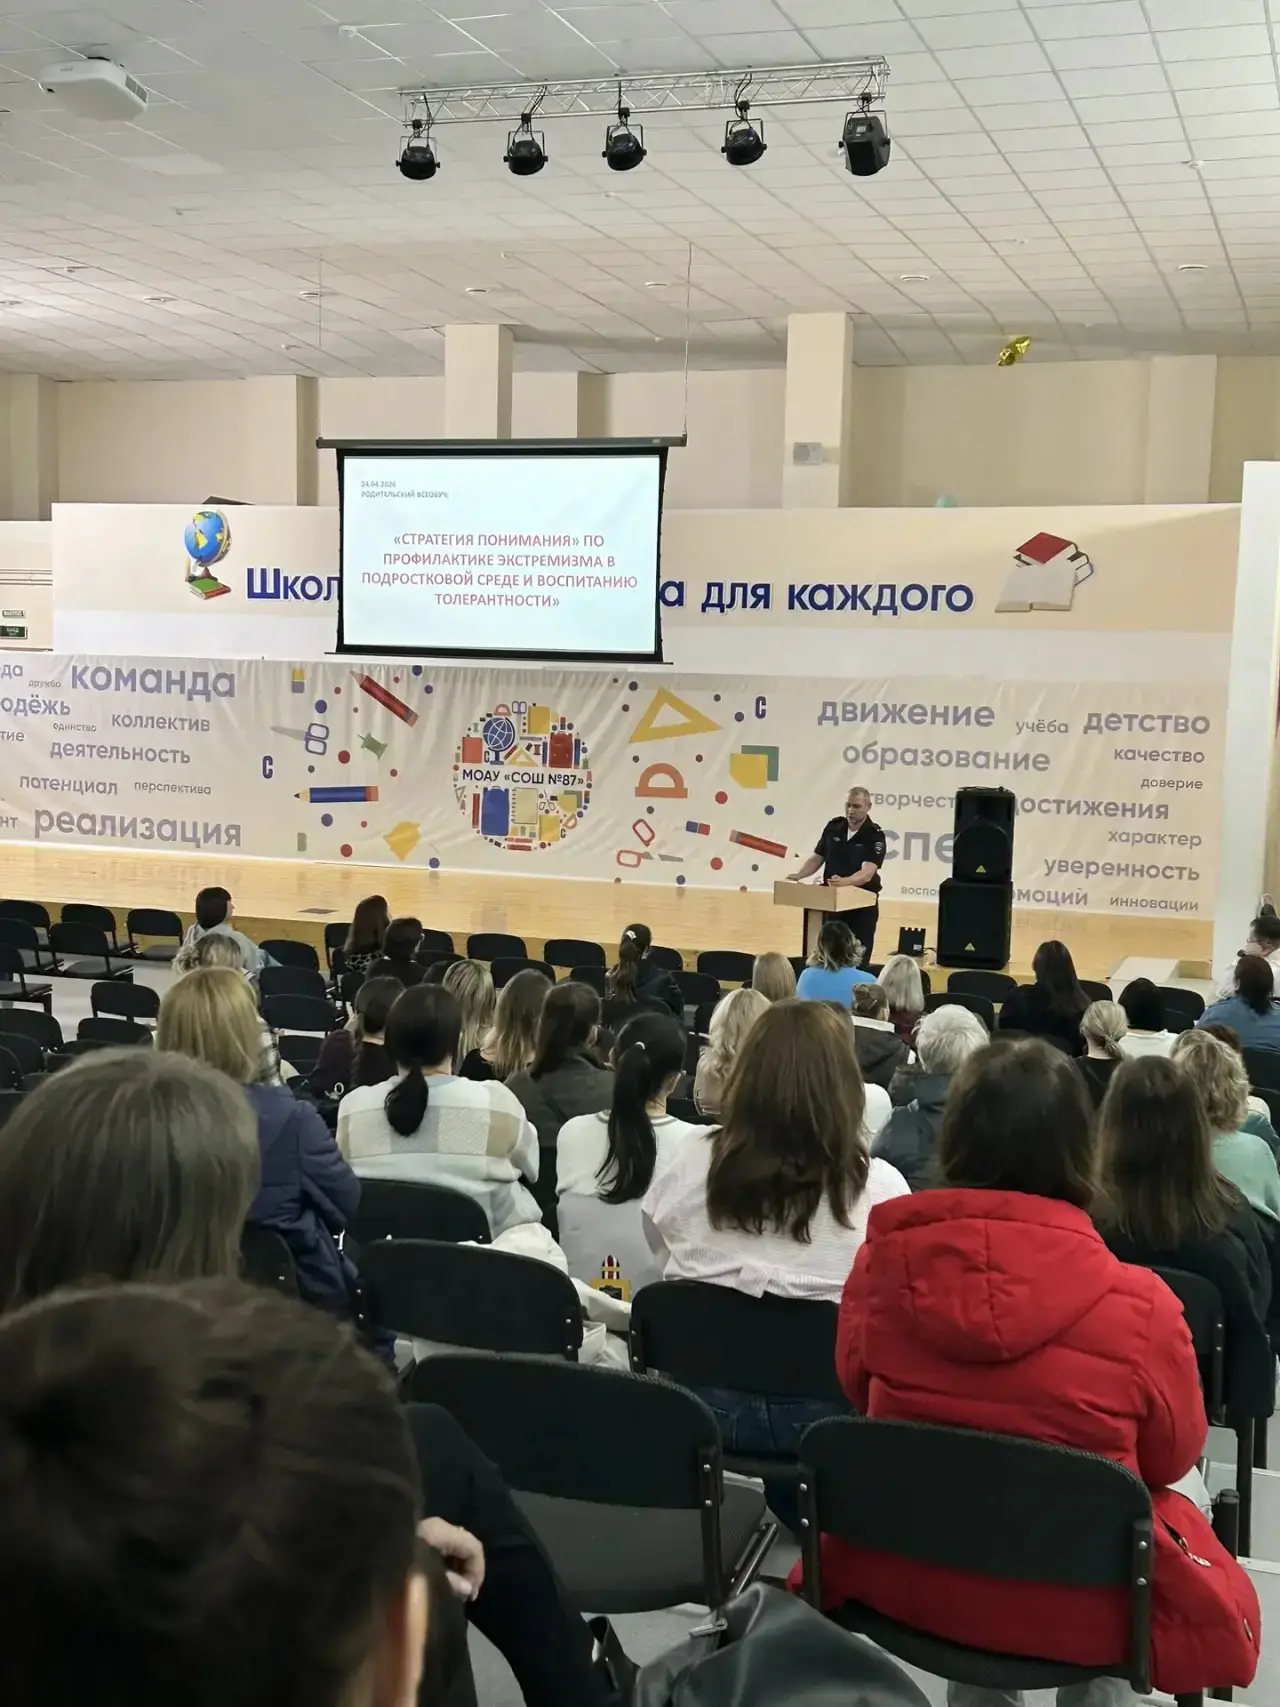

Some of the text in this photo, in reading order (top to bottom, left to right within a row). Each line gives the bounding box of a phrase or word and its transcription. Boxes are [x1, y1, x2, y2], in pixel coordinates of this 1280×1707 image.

[361, 489, 415, 499] РОДИТЕЛЬСКИЙ
[394, 532, 604, 549] «СТРАТЕГИЯ ПОНИМАНИЯ» ПО
[383, 552, 615, 569] ПРОФИЛАКТИКЕ ЭКСТРЕМИЗМА В
[362, 569, 638, 590] ПОДРОСТКОВОЙ СРЕДЕ И ВОСПИТАНИЮ
[435, 592, 560, 609] ТОЛЕРАНТНОСТИ»
[701, 581, 771, 614] для
[788, 582, 974, 616] каждого
[0, 664, 24, 679] да
[71, 665, 236, 703] команда
[111, 714, 210, 732] коллектив
[818, 700, 995, 728] движение
[1083, 711, 1211, 735] детство
[1016, 718, 1069, 735] учёба
[50, 742, 192, 765] деятельность
[842, 740, 1051, 772] образование
[1114, 747, 1205, 764] качество
[20, 776, 118, 796] потенциал
[134, 780, 211, 795] перспектива
[463, 769, 584, 787] МОАУ «СОШ №87»
[1140, 777, 1204, 791] доверие
[1014, 796, 1170, 820] остижения
[34, 809, 242, 849] реализация
[1107, 829, 1203, 850] характер
[1044, 857, 1200, 881] уверенность
[1012, 887, 1088, 906] моций
[1109, 896, 1200, 912] инновации
